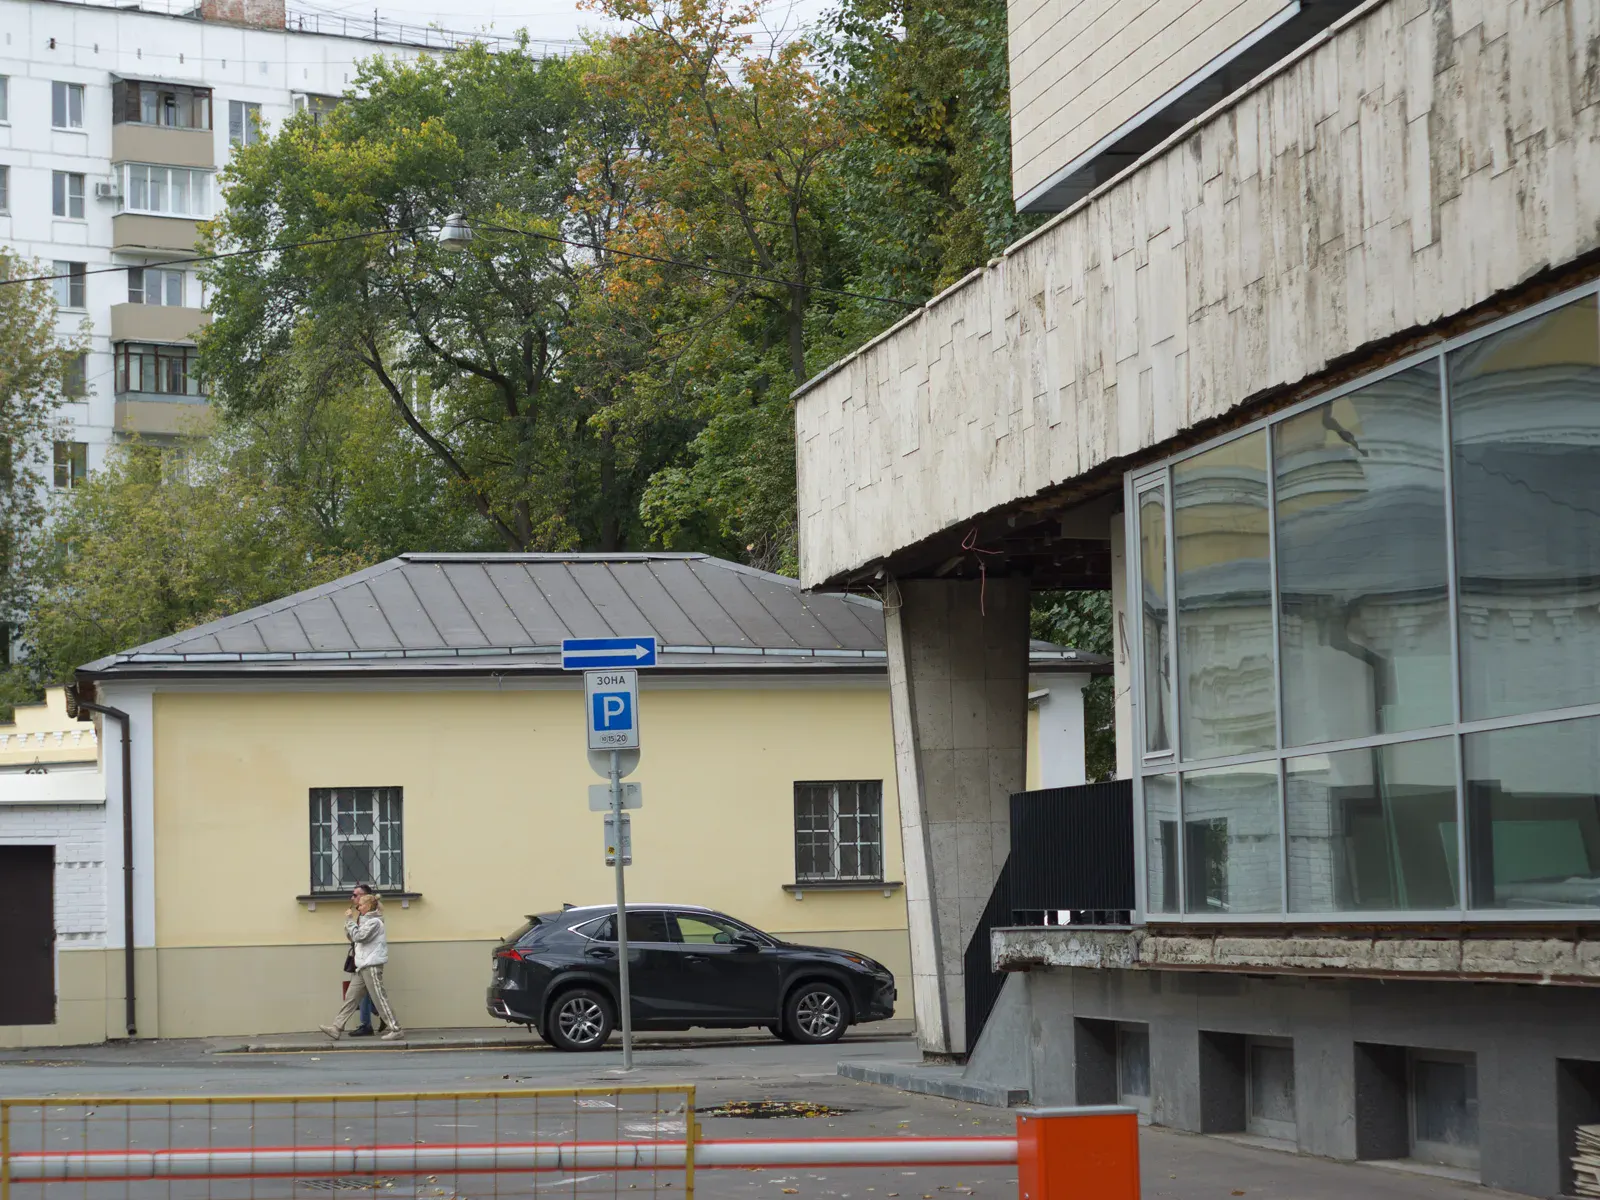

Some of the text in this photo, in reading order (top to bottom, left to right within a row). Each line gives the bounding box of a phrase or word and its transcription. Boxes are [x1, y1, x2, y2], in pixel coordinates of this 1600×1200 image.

[597, 676, 625, 685] ЗОНА
[603, 696, 625, 727] P
[616, 734, 626, 742] 20
